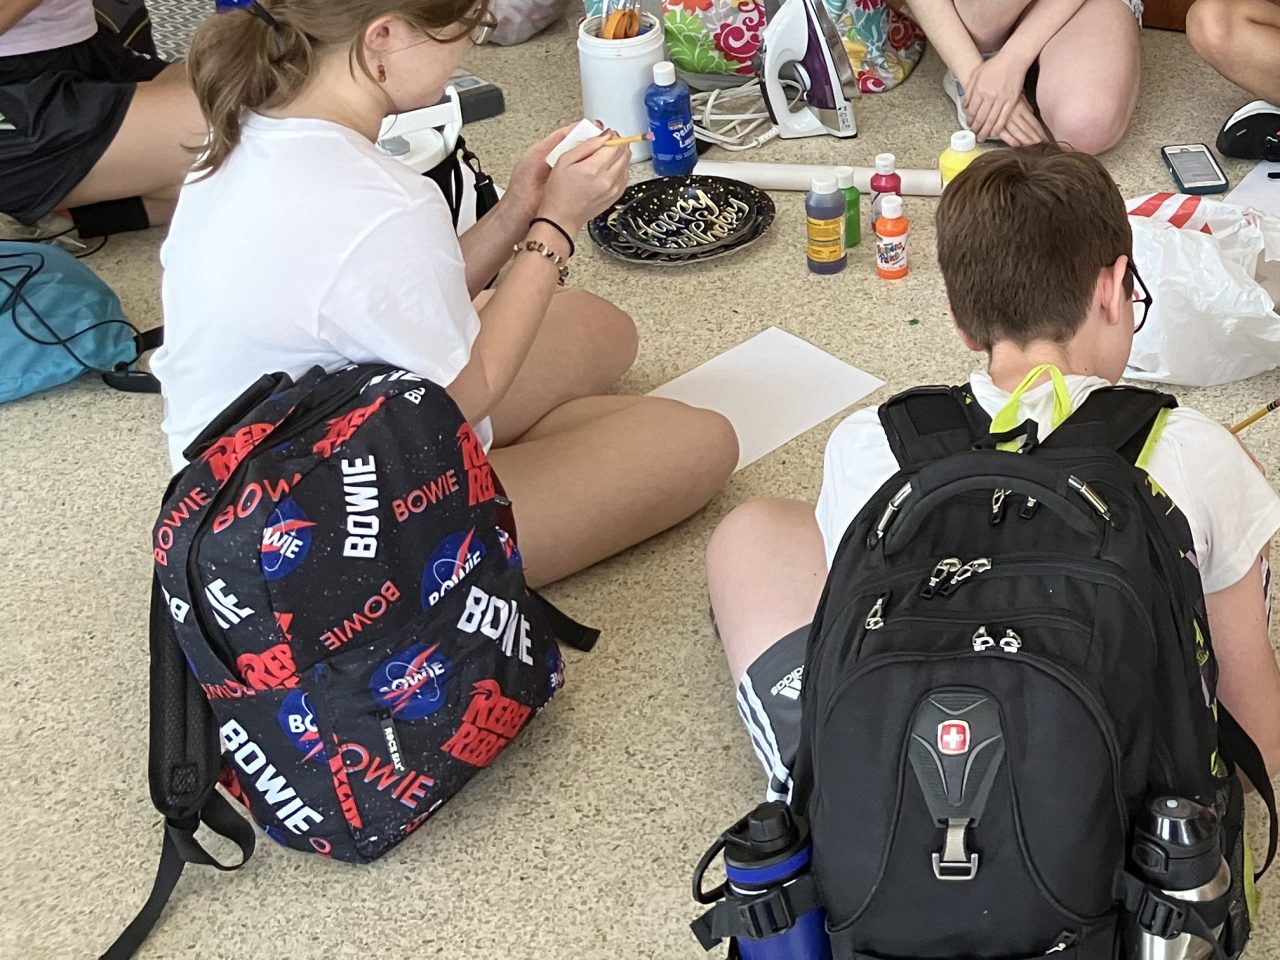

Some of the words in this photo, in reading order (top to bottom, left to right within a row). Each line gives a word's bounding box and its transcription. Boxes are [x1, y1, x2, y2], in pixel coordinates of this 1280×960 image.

[628, 189, 719, 239] Happy
[153, 487, 213, 566] BOWIE
[341, 454, 381, 559] BOWIE
[391, 468, 460, 523] BOWIE
[262, 527, 303, 559] WIE
[319, 580, 401, 651] BOWIE
[220, 718, 325, 835] BOWIE
